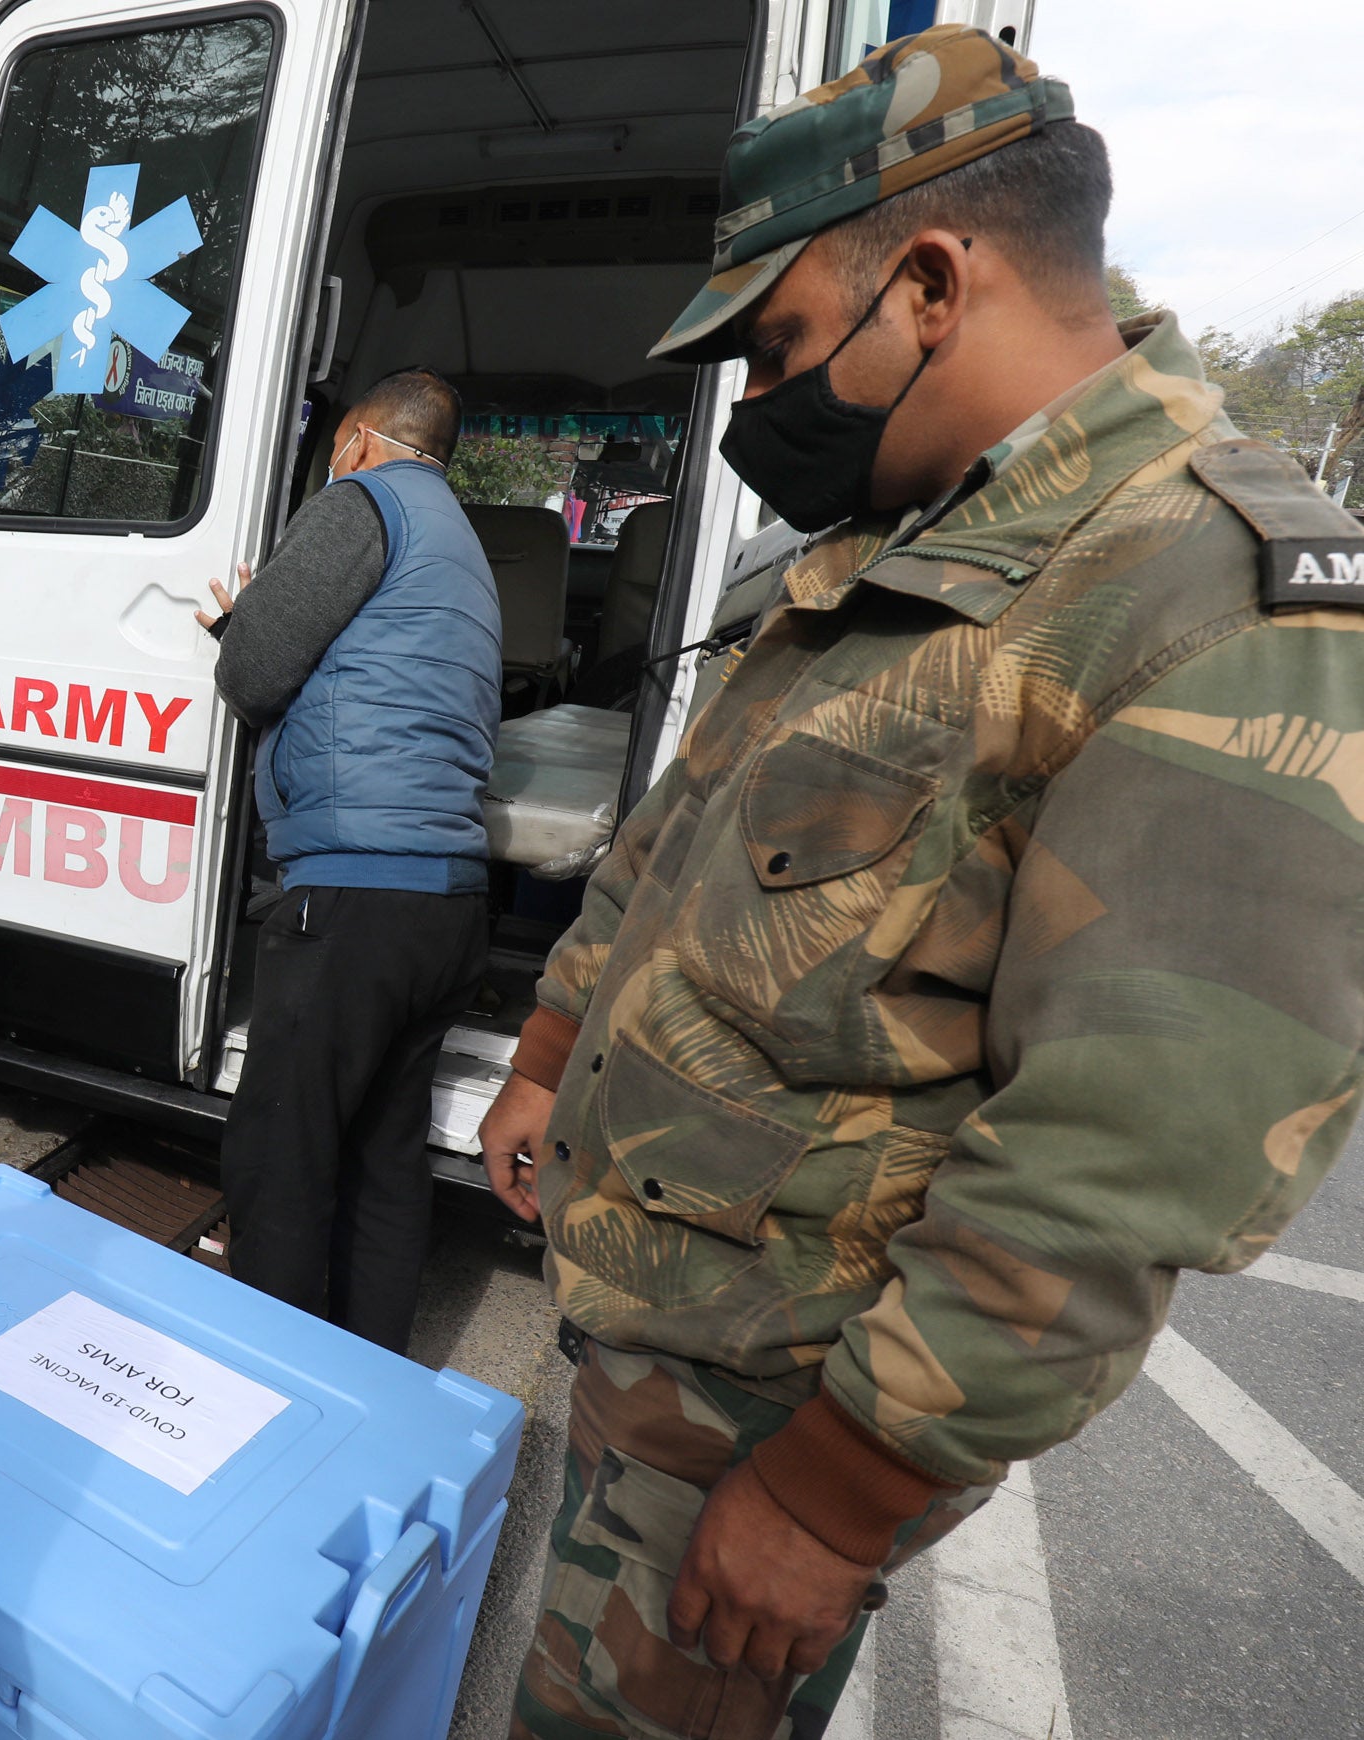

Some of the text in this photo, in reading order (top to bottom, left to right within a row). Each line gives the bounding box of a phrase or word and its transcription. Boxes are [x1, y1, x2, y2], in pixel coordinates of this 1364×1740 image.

[134, 378, 156, 406] जिला
[156, 389, 175, 413] एड्स
[29, 1352, 186, 1441] COVID-19 VACCINE
[78, 1342, 195, 1408] FOR AFMS
